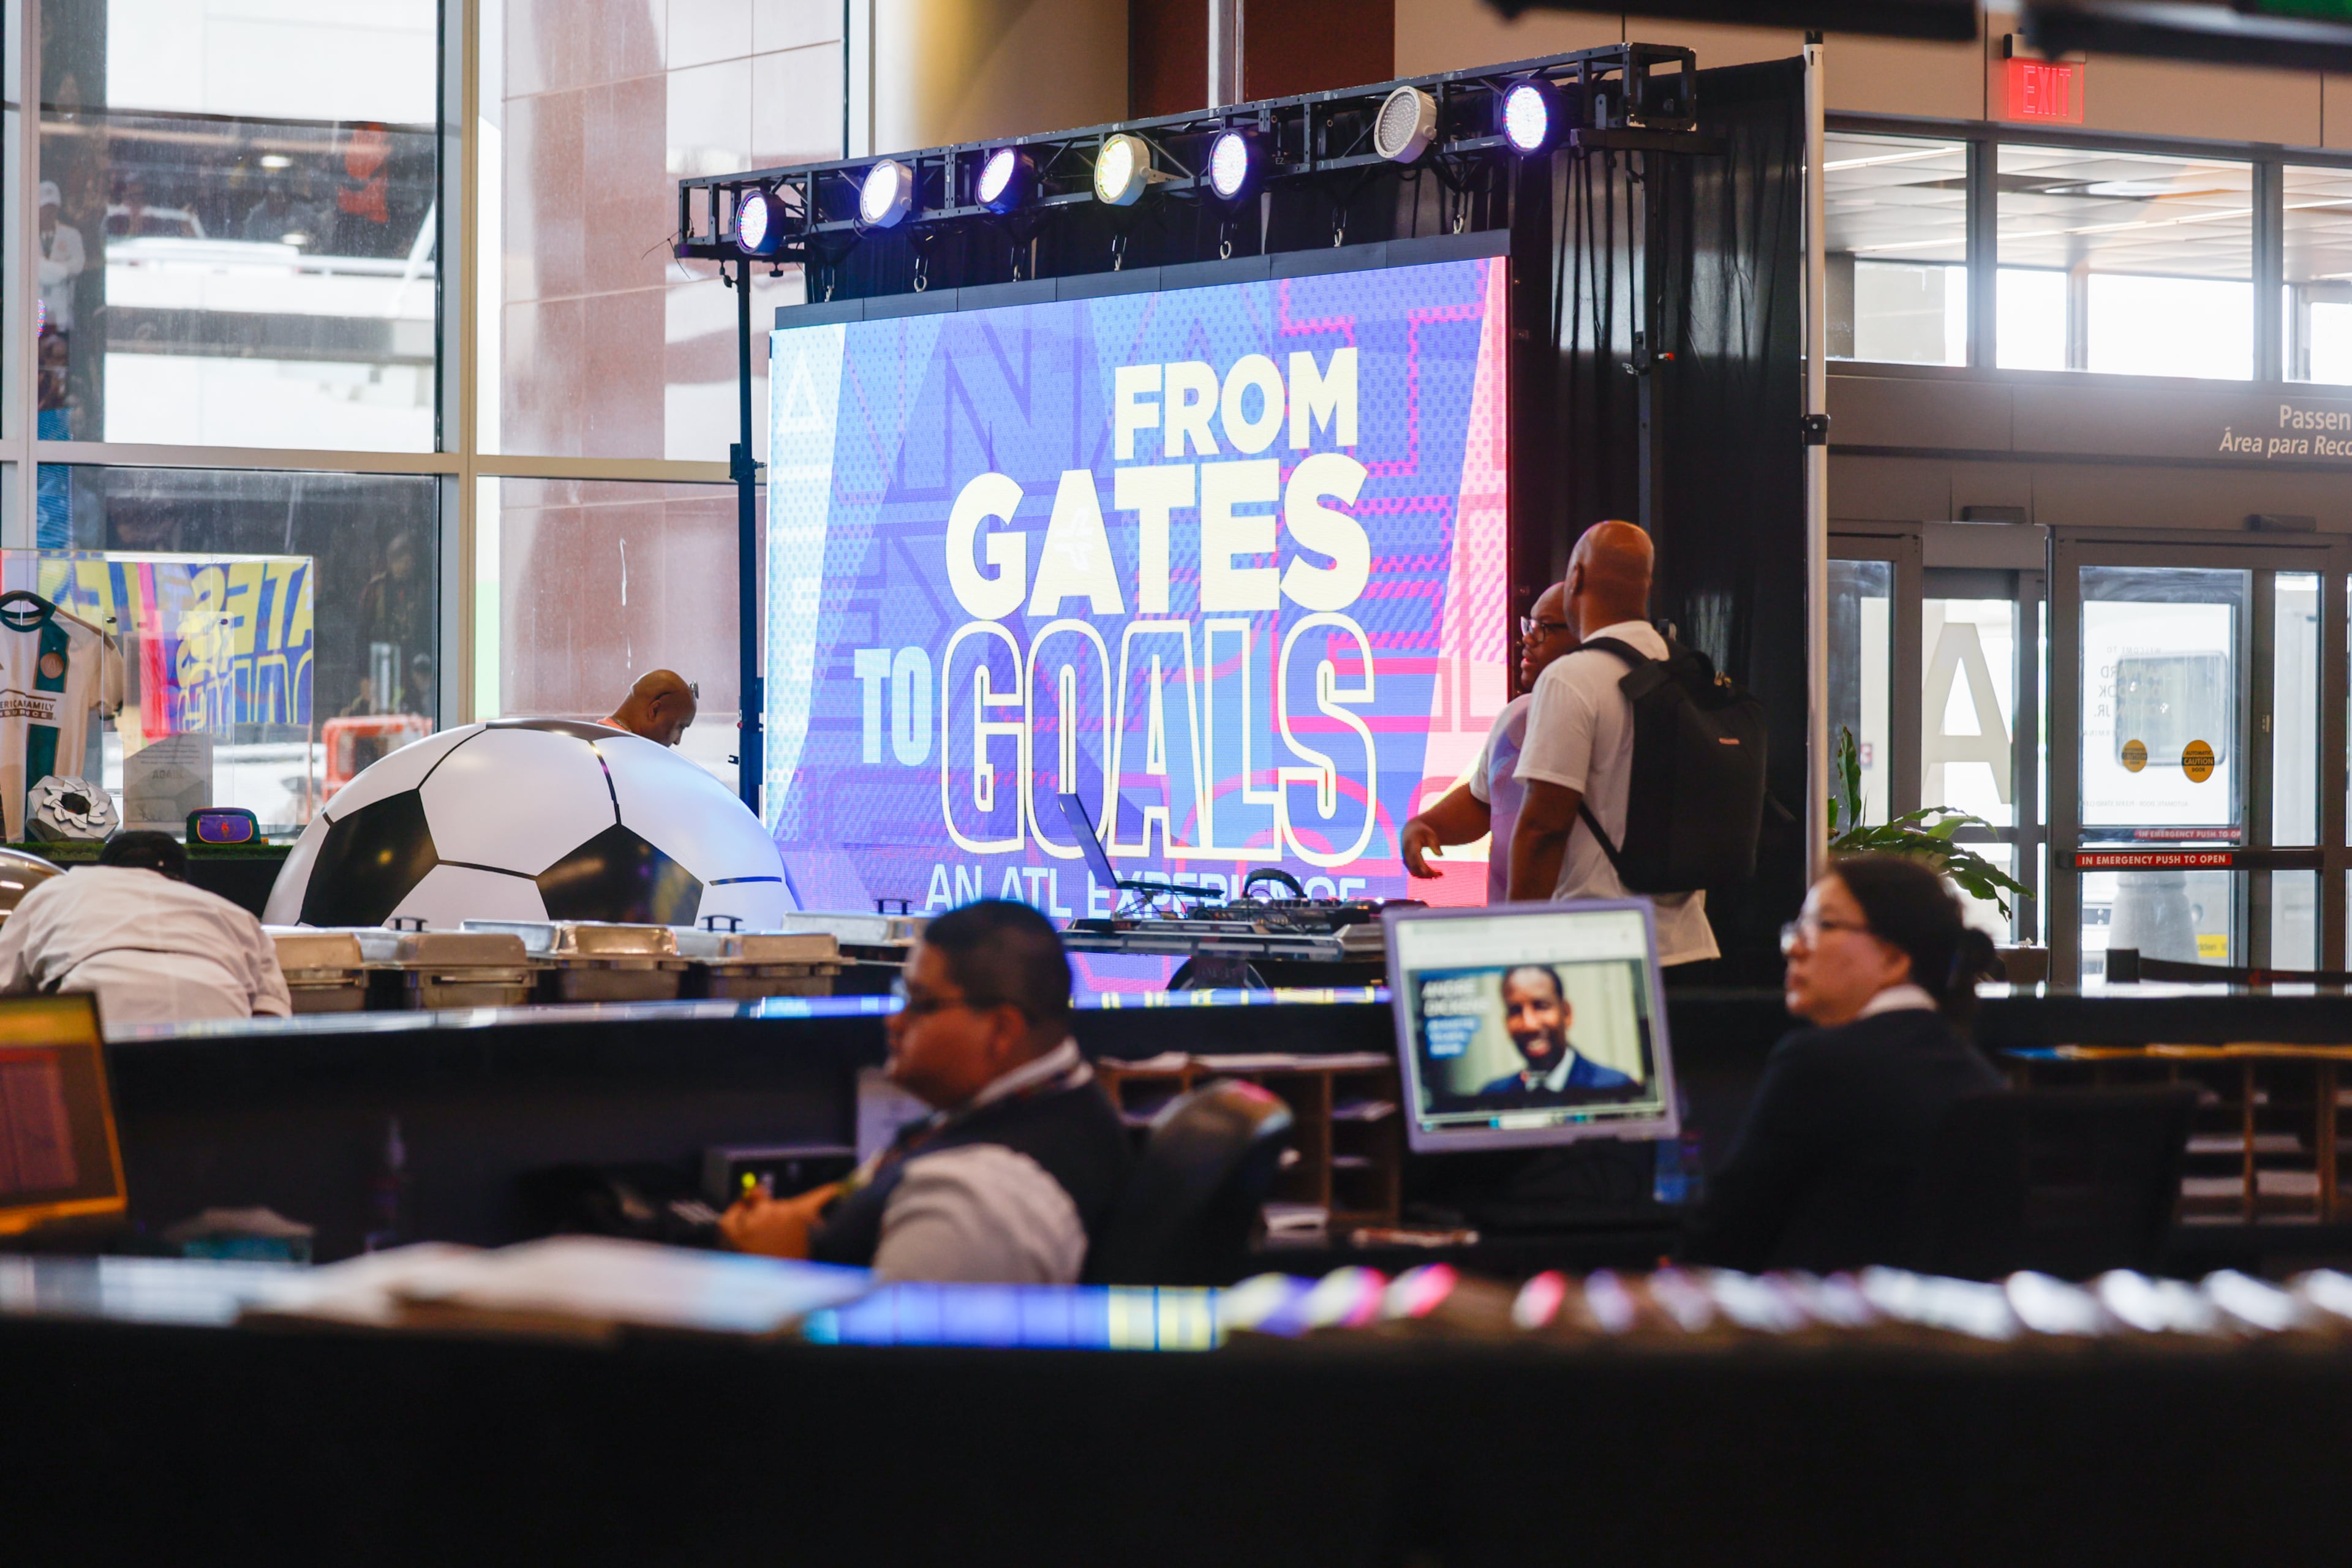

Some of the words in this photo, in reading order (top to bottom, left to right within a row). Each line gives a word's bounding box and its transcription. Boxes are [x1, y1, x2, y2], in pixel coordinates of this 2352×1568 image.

[2023, 65, 2071, 116] EXIT
[1114, 347, 1359, 461] FROM
[2280, 404, 2351, 431] Passen
[2218, 426, 2263, 453] Área
[2267, 437, 2309, 459] para
[945, 453, 1371, 619] GATES
[854, 646, 932, 767] TO
[941, 612, 1375, 868] GOALS
[1921, 622, 2011, 804] A
[2082, 856, 2093, 865] IN
[2097, 856, 2153, 865] EMERGENCY
[2155, 856, 2181, 864] PUSH
[2184, 855, 2196, 864] TO
[2199, 855, 2226, 864] OPEN
[925, 864, 982, 911] AN
[1000, 867, 1072, 918] ATL
